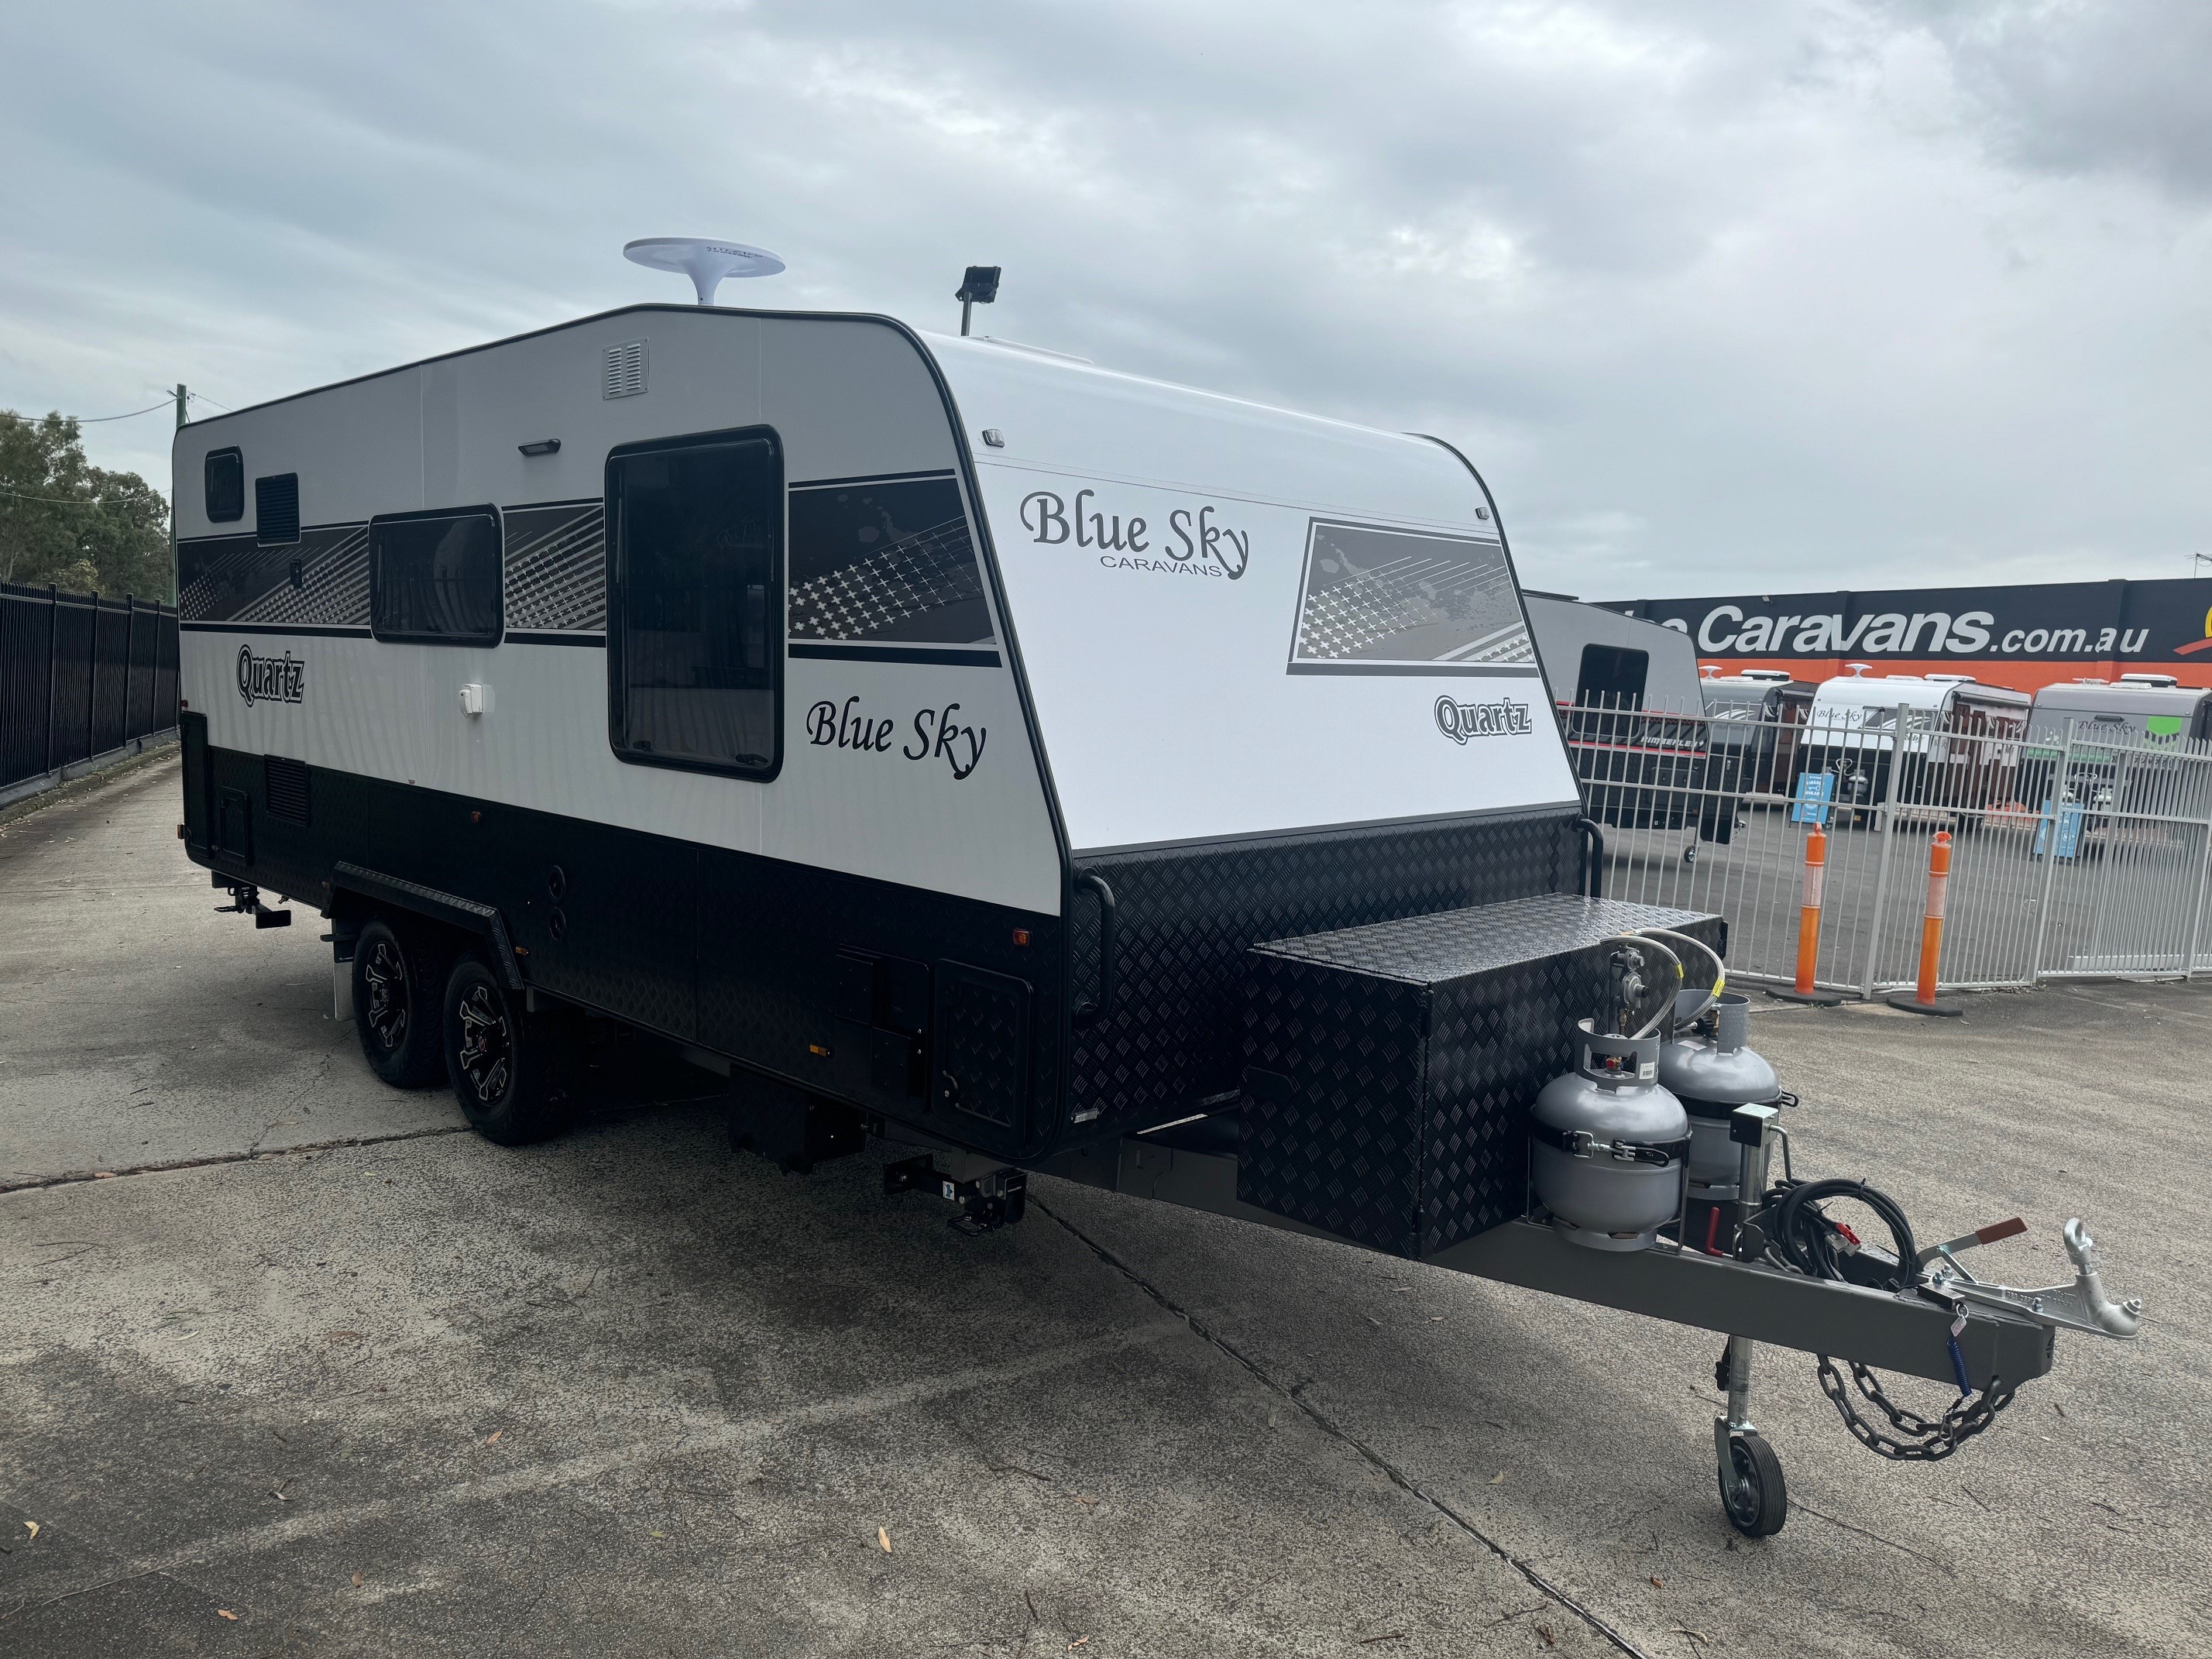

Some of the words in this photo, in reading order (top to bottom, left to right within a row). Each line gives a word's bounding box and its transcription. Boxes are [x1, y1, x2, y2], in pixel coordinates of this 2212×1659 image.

[1019, 489, 1150, 553] Blue
[1165, 505, 1249, 580] Sky
[1100, 555, 1223, 578] CARAVANS
[236, 644, 305, 708] Quartz
[806, 696, 894, 752] Blue
[903, 702, 987, 780] Sky
[1434, 695, 1532, 745] Quartz
